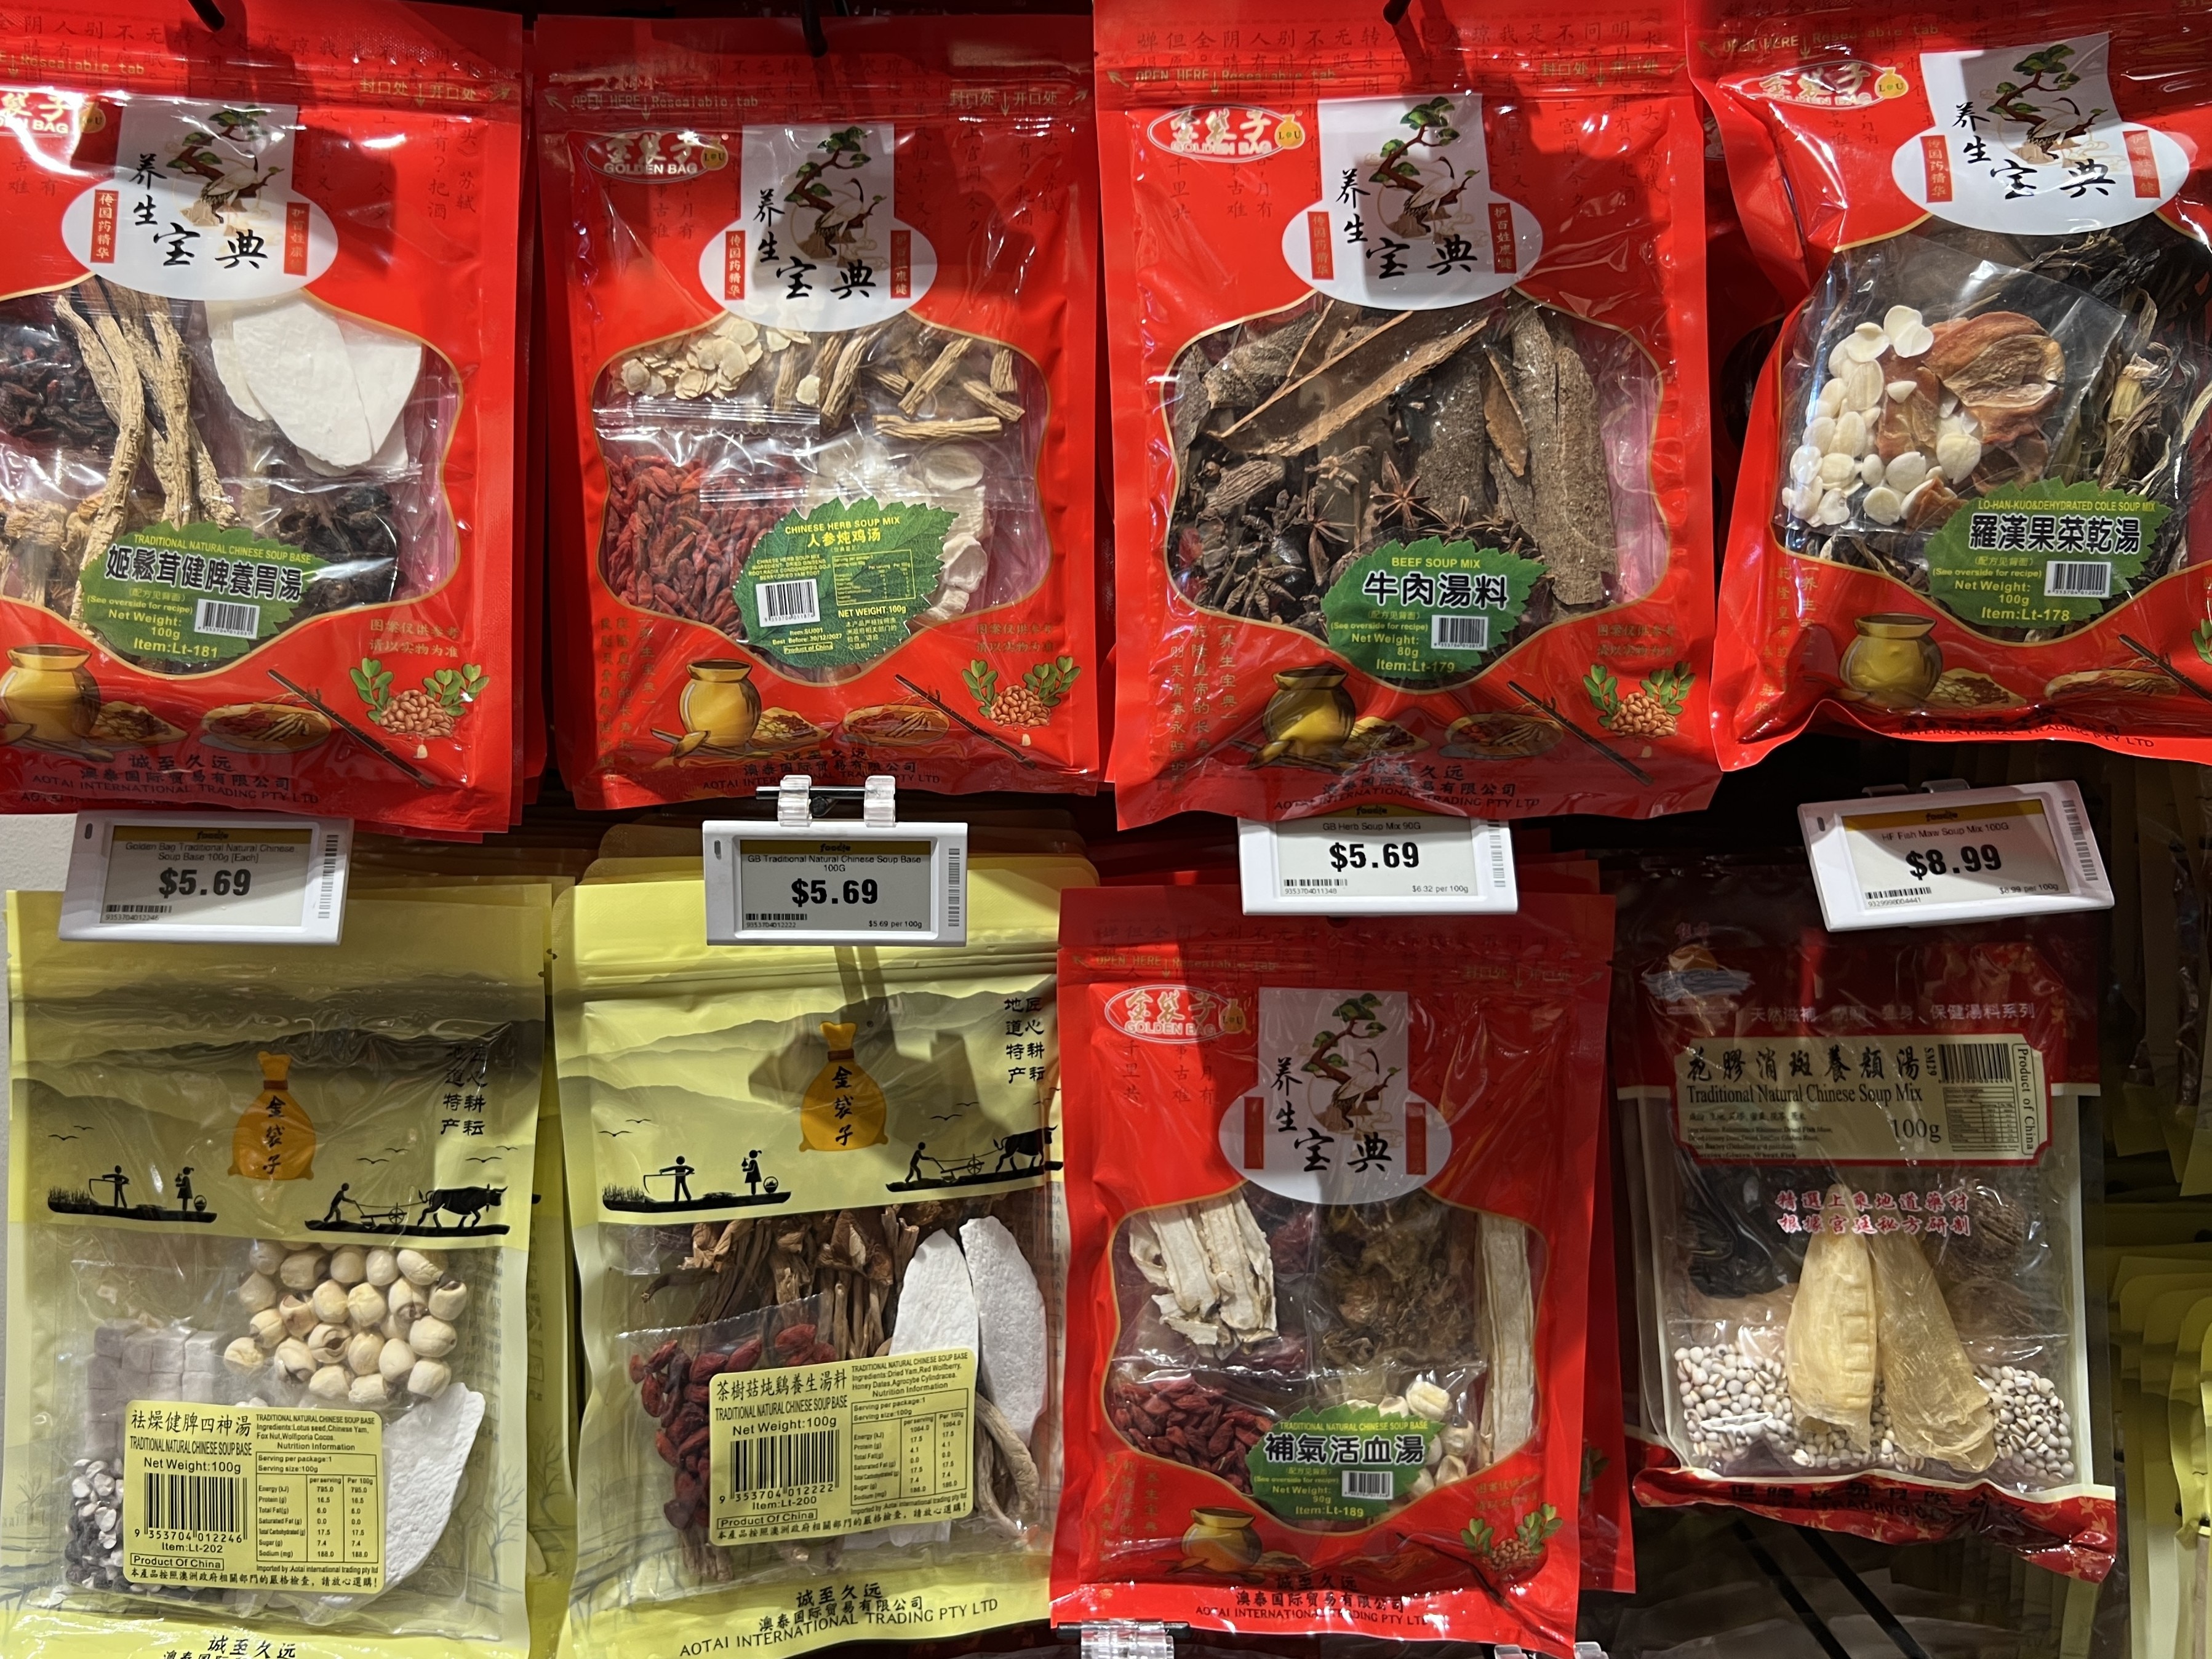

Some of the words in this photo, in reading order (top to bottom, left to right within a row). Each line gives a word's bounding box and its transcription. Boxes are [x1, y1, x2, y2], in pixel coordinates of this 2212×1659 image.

[360, 79, 408, 95] 封口处
[431, 83, 477, 102] 开口处
[33, 121, 68, 134] BAG
[604, 162, 663, 175] GOLDEN
[668, 164, 697, 175] BAG
[2094, 502, 2117, 511] COLE
[2118, 502, 2140, 512] SOUP
[2142, 503, 2155, 512] MIX
[785, 524, 825, 535] CHINESE
[827, 521, 852, 531] HERB
[854, 519, 880, 529] SOUP
[882, 517, 900, 526] MIX
[1970, 514, 2139, 553] 羅漢果菜乾湯
[807, 527, 881, 548] 人参炖鸡汤
[134, 534, 186, 550] TRADITIONAL
[189, 540, 227, 554] NATURAL
[229, 545, 263, 559] CHINESE
[265, 550, 289, 562] SOUP
[290, 552, 311, 564] BASE
[1392, 558, 1422, 567] BEEF
[1426, 558, 1457, 568] SOUP
[1460, 559, 1480, 569] MIX
[2010, 570, 2042, 578] recipe)
[1363, 572, 1507, 609] 牛肉湯料
[1955, 580, 1978, 590] Net
[1980, 582, 2030, 593] Weight:
[1999, 594, 2029, 607] 100g
[108, 609, 130, 621] Net
[134, 611, 182, 628] Weight:
[838, 609, 854, 618] NET
[1982, 607, 2070, 622] Item:Lt-178
[151, 626, 180, 641] 100g
[1351, 633, 1371, 643] Net
[1374, 634, 1419, 646] Weight:
[134, 637, 218, 659] Item:Lt-181
[1397, 647, 1418, 658] 80g
[1376, 658, 1455, 673] Item:Lt-179
[1323, 822, 1336, 831] GB
[1361, 822, 1384, 832] Soup
[1386, 822, 1401, 831] Mix
[1403, 822, 1421, 831] 90G
[1882, 833, 1895, 842] HF
[1919, 828, 1939, 839] Maw
[1942, 826, 1965, 837] Soup
[1967, 825, 1983, 834] Mix
[1985, 822, 2009, 833] 100G
[125, 842, 157, 852] Golden
[159, 842, 177, 853] Bag
[179, 842, 223, 853] Traditional
[226, 844, 258, 853] Natural
[260, 844, 295, 853] Chinese
[158, 853, 181, 862] Soup
[183, 853, 206, 862] Base
[208, 853, 230, 863] 100g
[748, 855, 761, 863] GB
[763, 854, 806, 863] Traditional
[809, 854, 839, 863] Natural
[841, 855, 874, 863] Chinese
[877, 855, 898, 864] Soup
[900, 855, 920, 863] Base
[1329, 842, 1419, 872] $5.69
[1905, 844, 2002, 881] $8.99
[823, 863, 846, 873] 100G
[158, 867, 251, 899] $5.69
[1450, 885, 1468, 893] 100g
[791, 878, 878, 908] $5.69
[1124, 1021, 1183, 1035] GOLDEN
[1186, 1023, 1216, 1035] BAG
[2018, 1049, 2031, 1092] Product
[1687, 1085, 1754, 1103] Traditional
[1758, 1084, 1803, 1103] Natural
[1807, 1084, 1856, 1102] Chinese
[1859, 1084, 1891, 1107] Soup
[1895, 1083, 1922, 1102] Mix
[2023, 1098, 2034, 1111] of
[1893, 1119, 1941, 1143] 100g
[2024, 1116, 2036, 1149] China
[733, 1425, 755, 1436] Net
[759, 1417, 837, 1433] Weight:100g
[130, 1436, 164, 1452] TRADITIONAL
[166, 1439, 191, 1454] NATURAL
[192, 1441, 217, 1455] CHINESE
[218, 1442, 235, 1455] SOUP
[236, 1442, 252, 1456] BASE
[1264, 1434, 1424, 1464] 補氣活血湯
[144, 1457, 164, 1468] Net
[167, 1460, 241, 1474] Weight:100g
[753, 1497, 817, 1510] Item:Lt-200
[1296, 1506, 1364, 1517] Item:Lt-189
[721, 1515, 764, 1527] Product
[767, 1514, 779, 1523] Of
[783, 1511, 814, 1521] China
[162, 1542, 223, 1553] Item:Lt-202
[134, 1556, 173, 1567] Product
[190, 1559, 221, 1569] China
[796, 1582, 883, 1607] 诚至久远
[758, 1596, 922, 1632] 澳泰国际贸易有限公司
[680, 1637, 729, 1657] AOTAI
[737, 1614, 858, 1648] INTERNATIONAL
[864, 1609, 933, 1625] TRADING
[939, 1605, 967, 1621] PTY
[973, 1599, 998, 1615] LTD
[208, 1635, 295, 1658] 诚至久远
